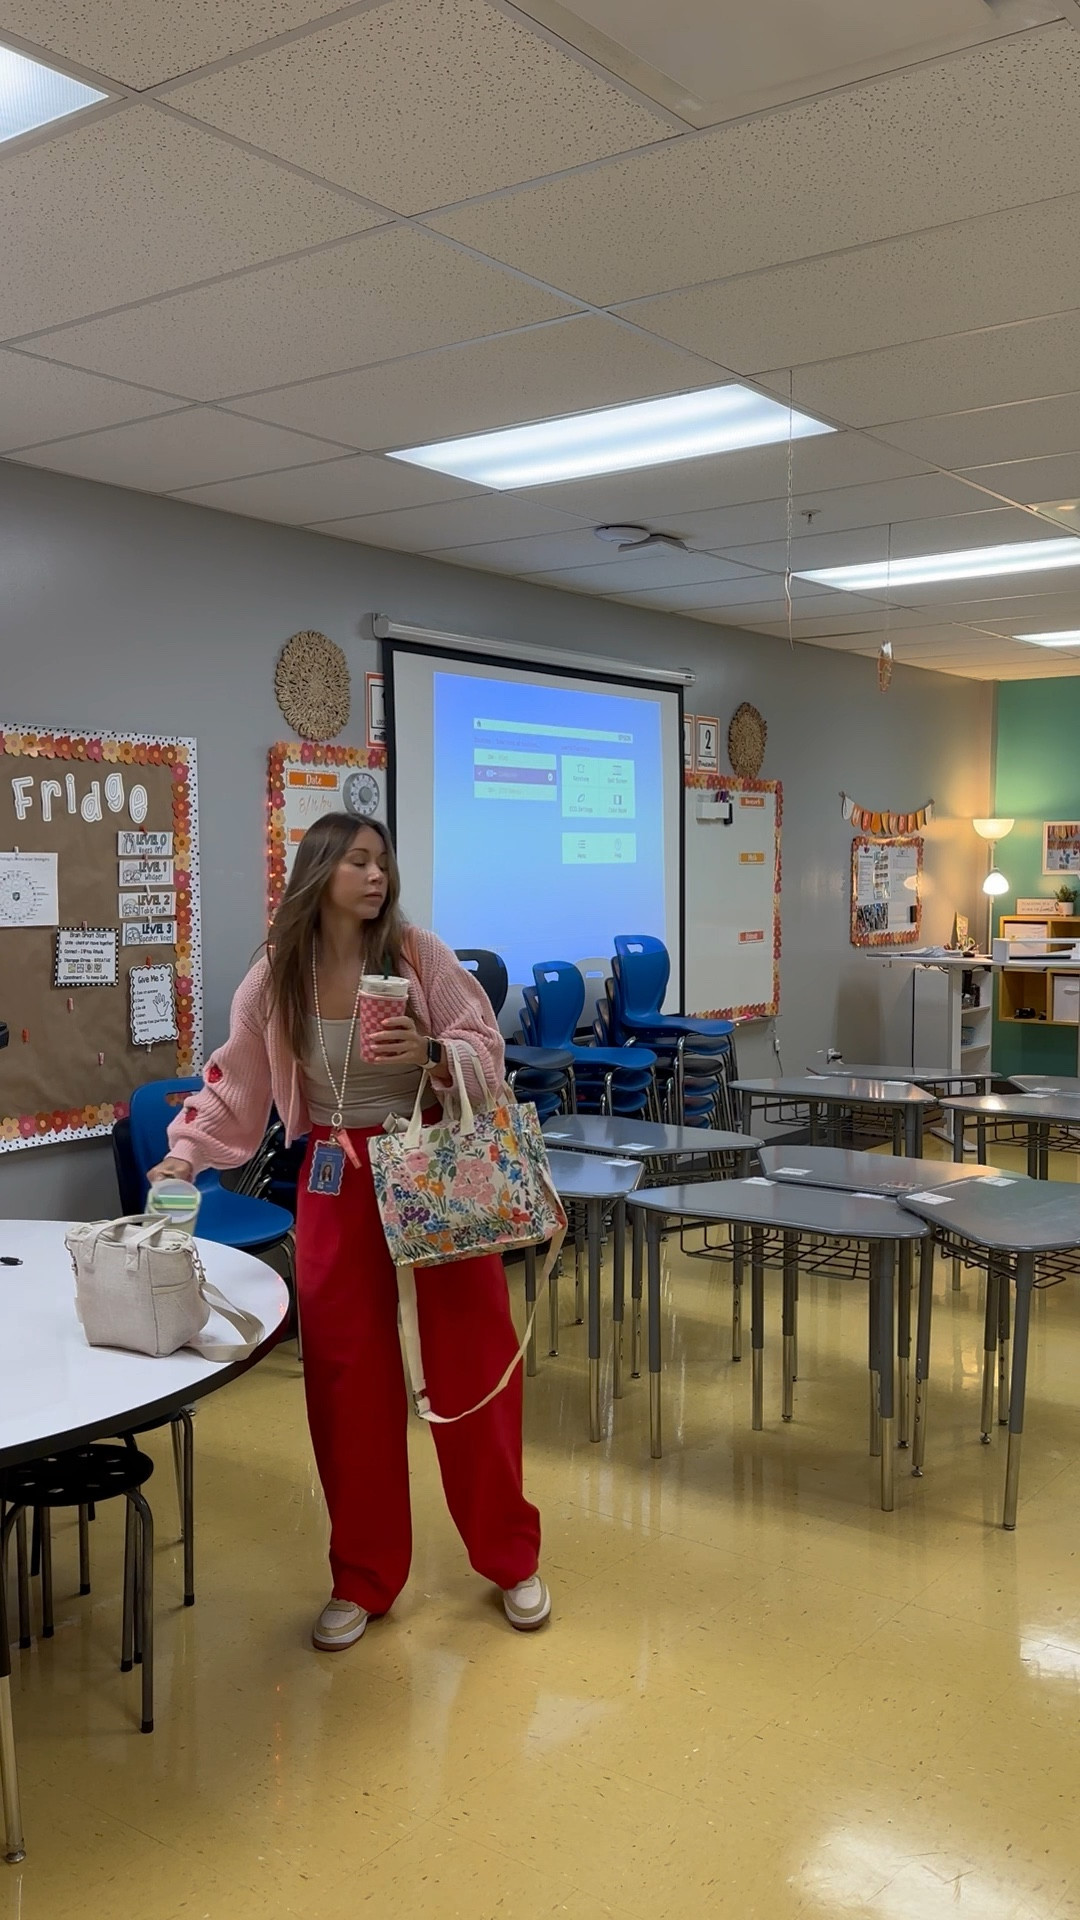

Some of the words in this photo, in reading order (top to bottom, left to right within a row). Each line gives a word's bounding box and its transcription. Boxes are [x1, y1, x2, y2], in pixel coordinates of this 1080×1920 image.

[705, 729, 711, 749] 2
[306, 774, 322, 785] Date
[12, 773, 148, 824] Fridge
[136, 834, 158, 846] LEVEL
[160, 834, 167, 846] 0
[139, 861, 161, 873] LEVEL
[163, 861, 167, 873] 1
[138, 895, 161, 906] LEVEL
[164, 895, 170, 905] 2
[142, 924, 164, 935] LEVEL
[166, 924, 172, 934] 3
